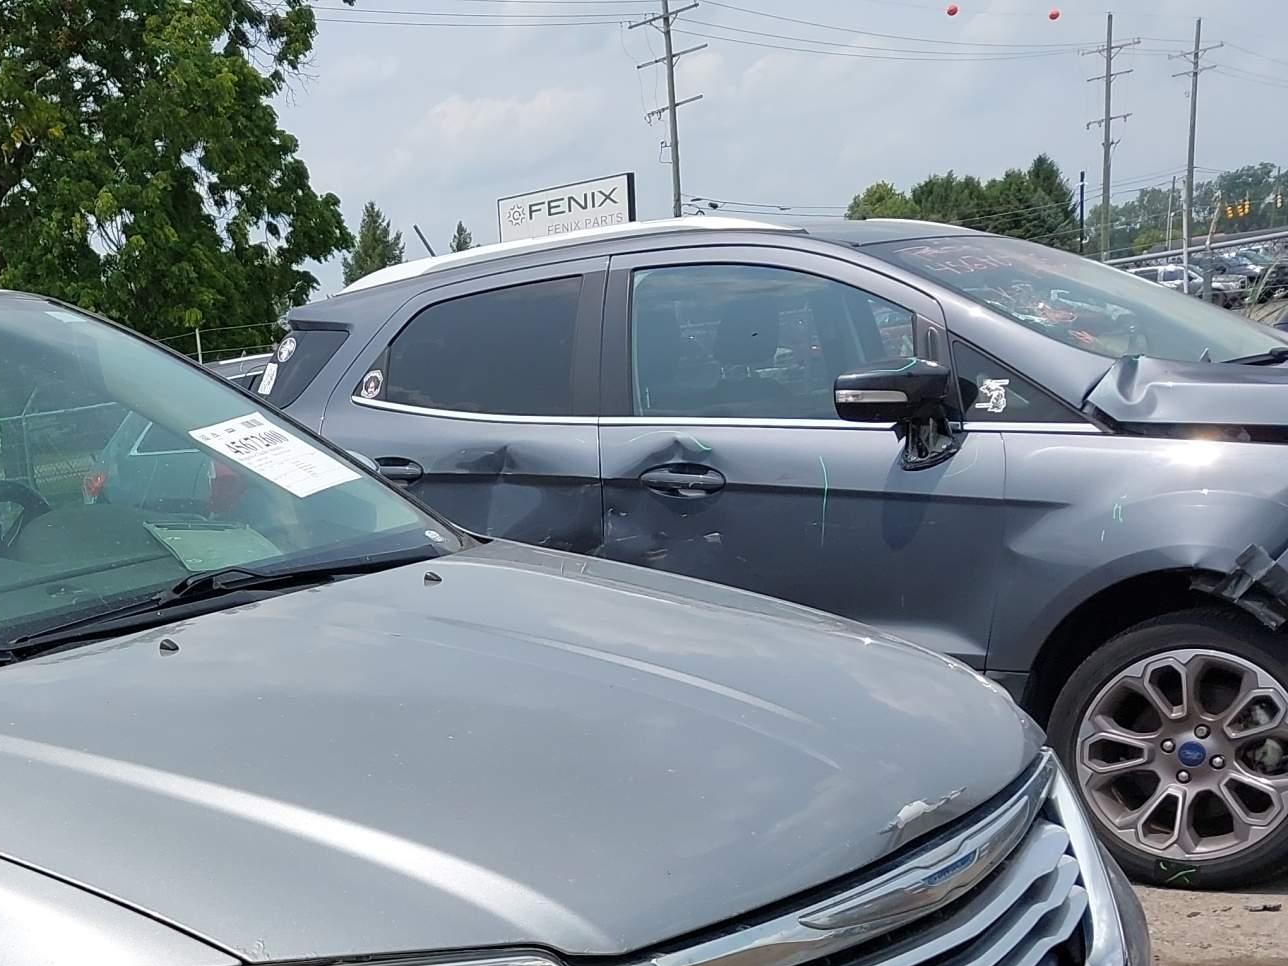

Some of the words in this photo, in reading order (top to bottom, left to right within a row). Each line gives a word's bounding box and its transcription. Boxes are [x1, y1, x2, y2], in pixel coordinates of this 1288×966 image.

[528, 187, 619, 220] FENIX
[547, 221, 581, 235] FENIX
[584, 212, 624, 229] PARTS
